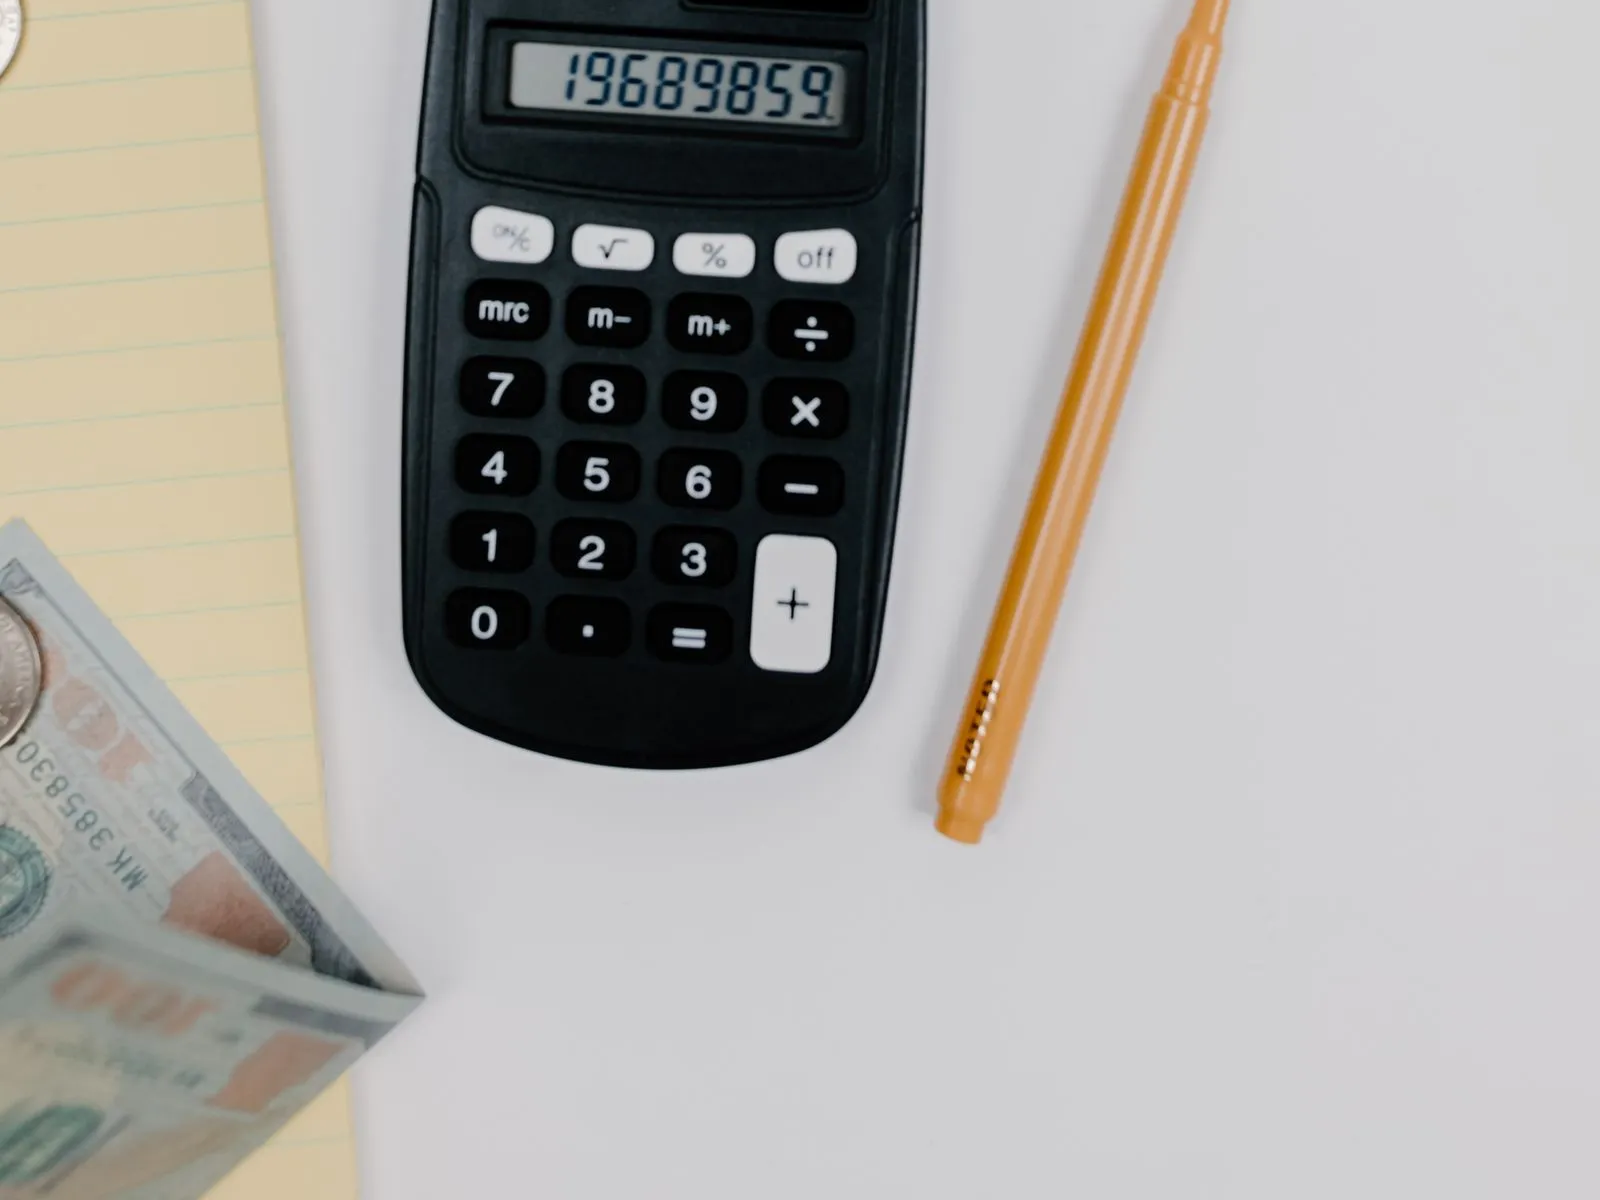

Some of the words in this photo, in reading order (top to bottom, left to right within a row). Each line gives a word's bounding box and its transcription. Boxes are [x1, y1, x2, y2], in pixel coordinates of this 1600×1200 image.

[797, 247, 836, 268] off
[478, 299, 530, 324] mrc
[687, 314, 731, 337] m+
[487, 371, 514, 406] 7
[587, 379, 615, 414] 8
[690, 386, 718, 421] 9
[480, 450, 508, 485] 4
[583, 456, 610, 492] 5
[685, 464, 712, 499] 6
[482, 528, 498, 562] 1
[577, 535, 606, 570] 2
[680, 542, 707, 577] 3
[471, 605, 498, 640] 0
[15, 738, 116, 853] 385830
[107, 845, 148, 891] MK
